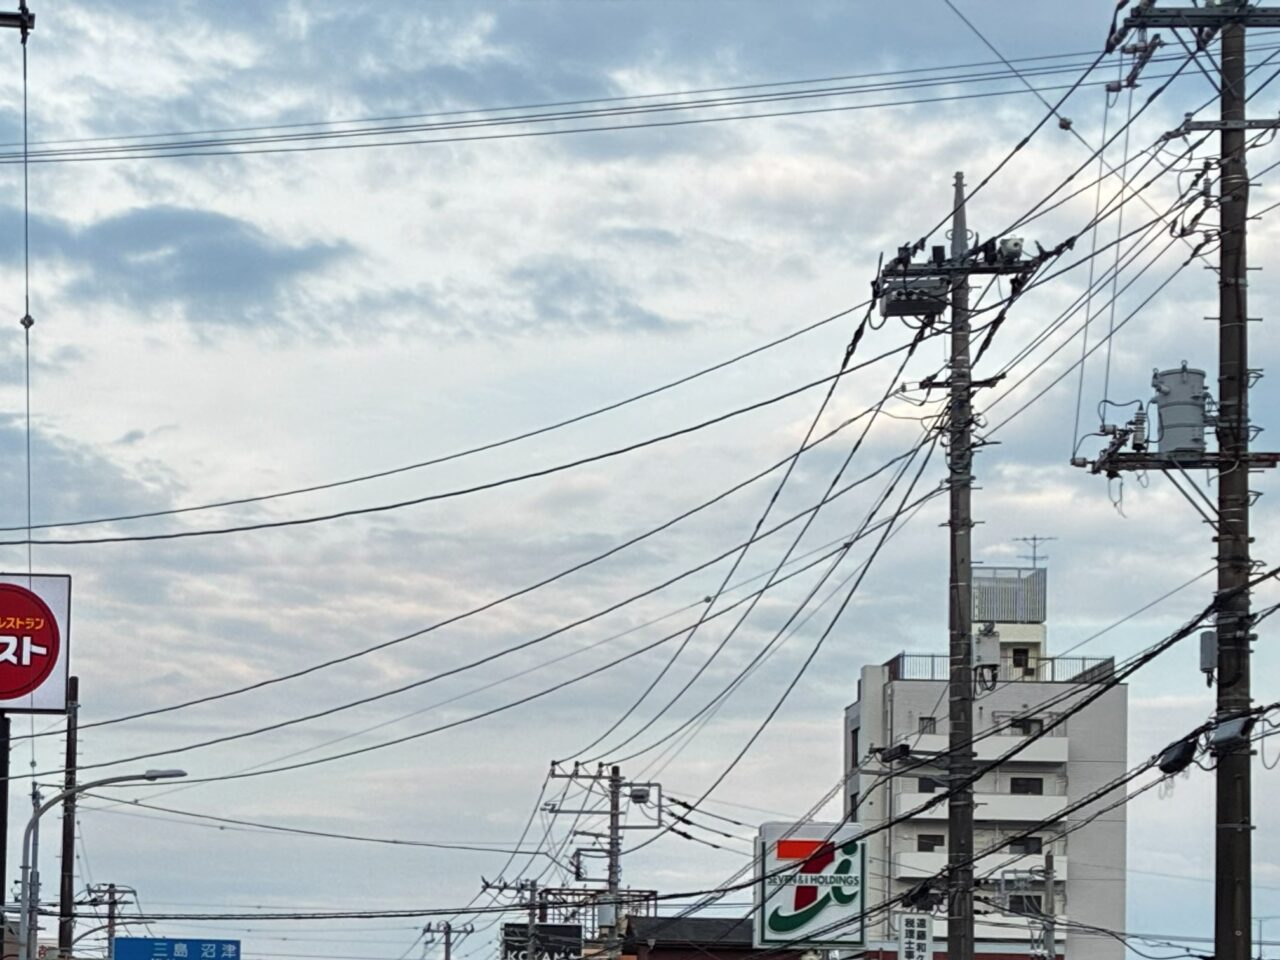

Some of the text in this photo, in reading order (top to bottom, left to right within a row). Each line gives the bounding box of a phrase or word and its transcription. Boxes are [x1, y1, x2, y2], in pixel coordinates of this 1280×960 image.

[810, 875, 859, 885] HOLDINGS
[153, 942, 237, 958] 三島 沼津
